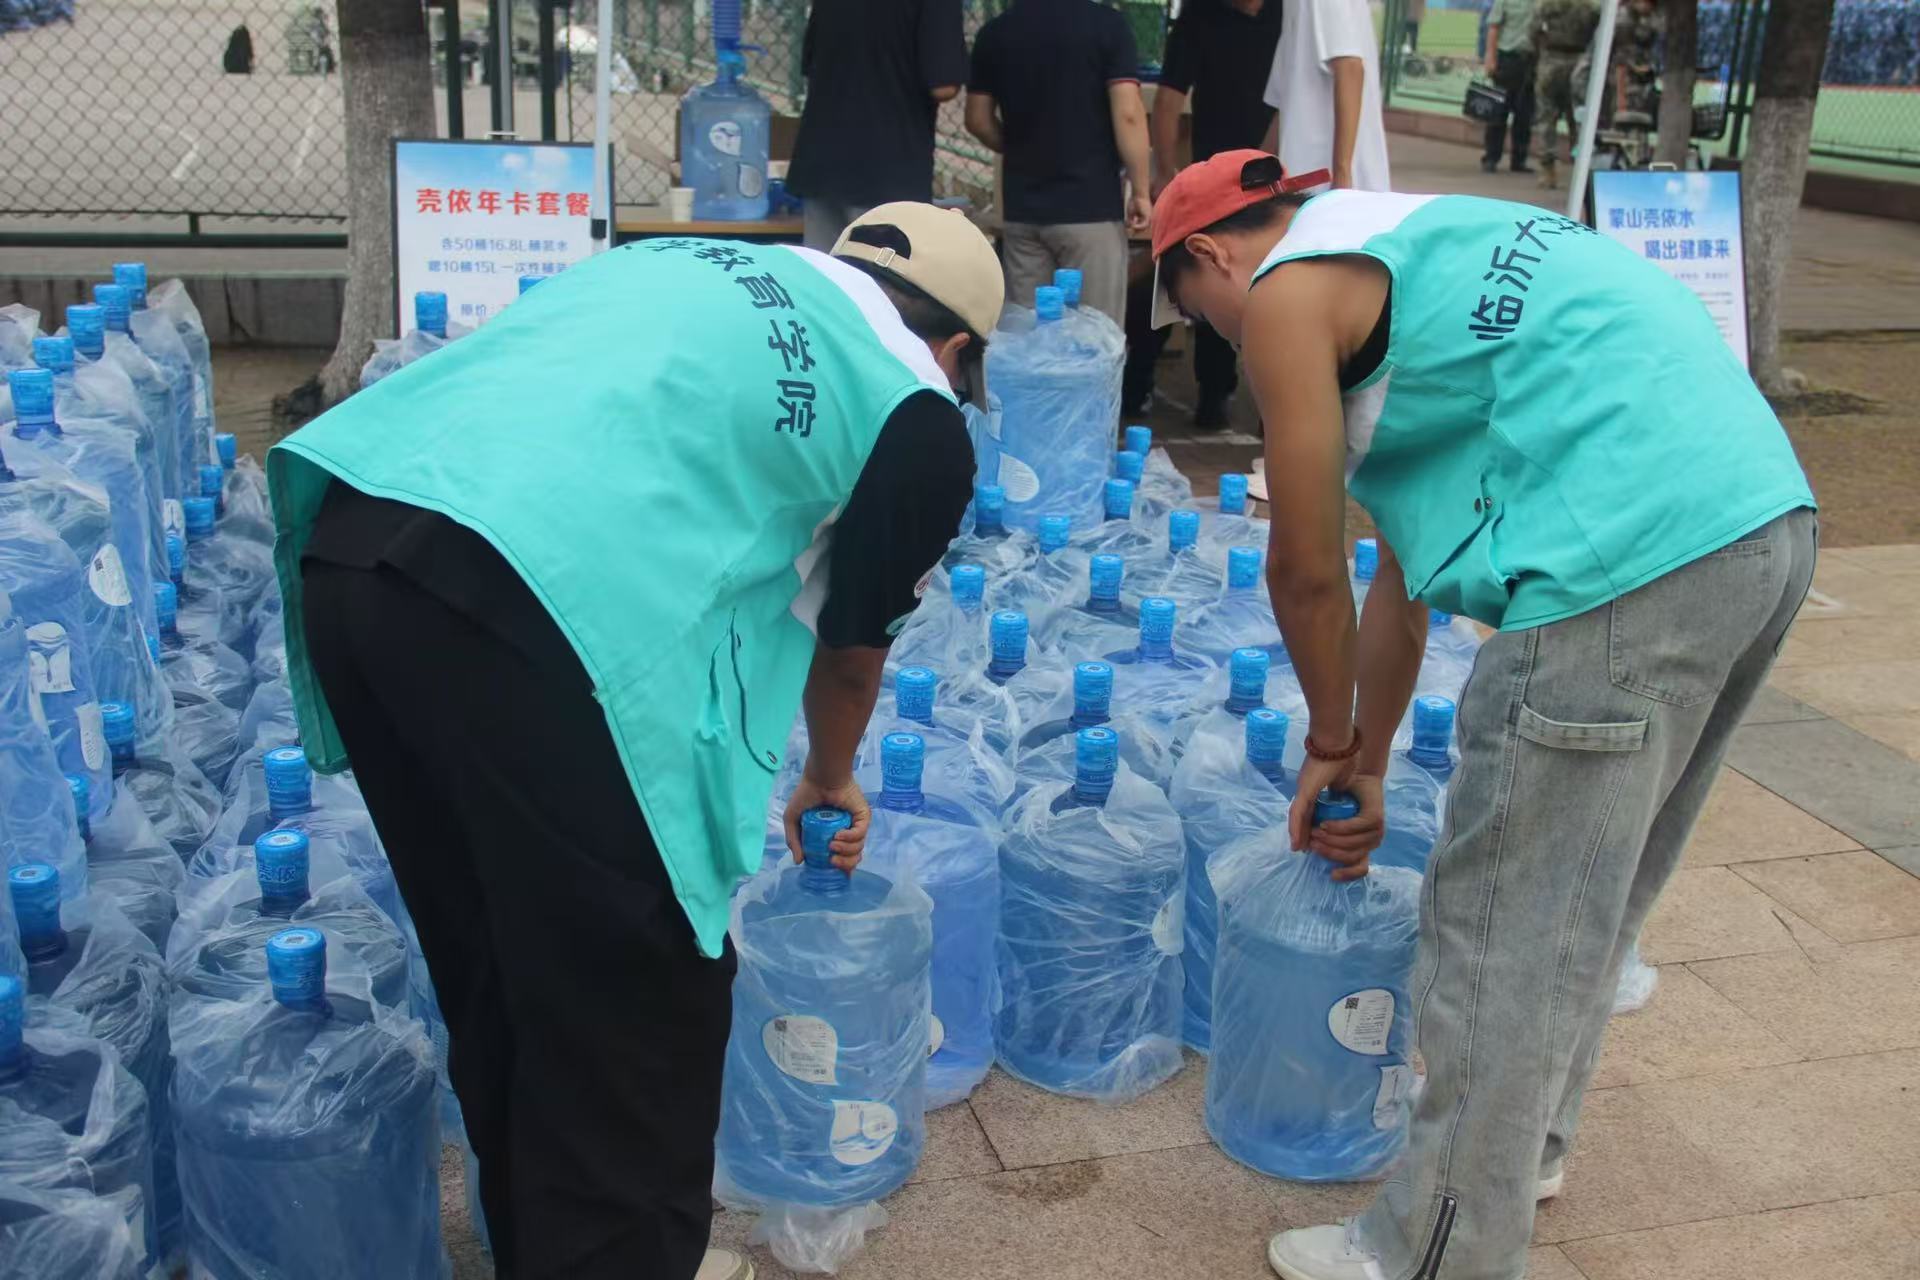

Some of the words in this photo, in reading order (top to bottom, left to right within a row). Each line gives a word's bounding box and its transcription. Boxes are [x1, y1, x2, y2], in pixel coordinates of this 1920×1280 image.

[416, 188, 592, 217] 壳依年卡套餐
[1608, 208, 1695, 229] 蒙山壳依水
[1645, 239, 1730, 260] 喝出健康来
